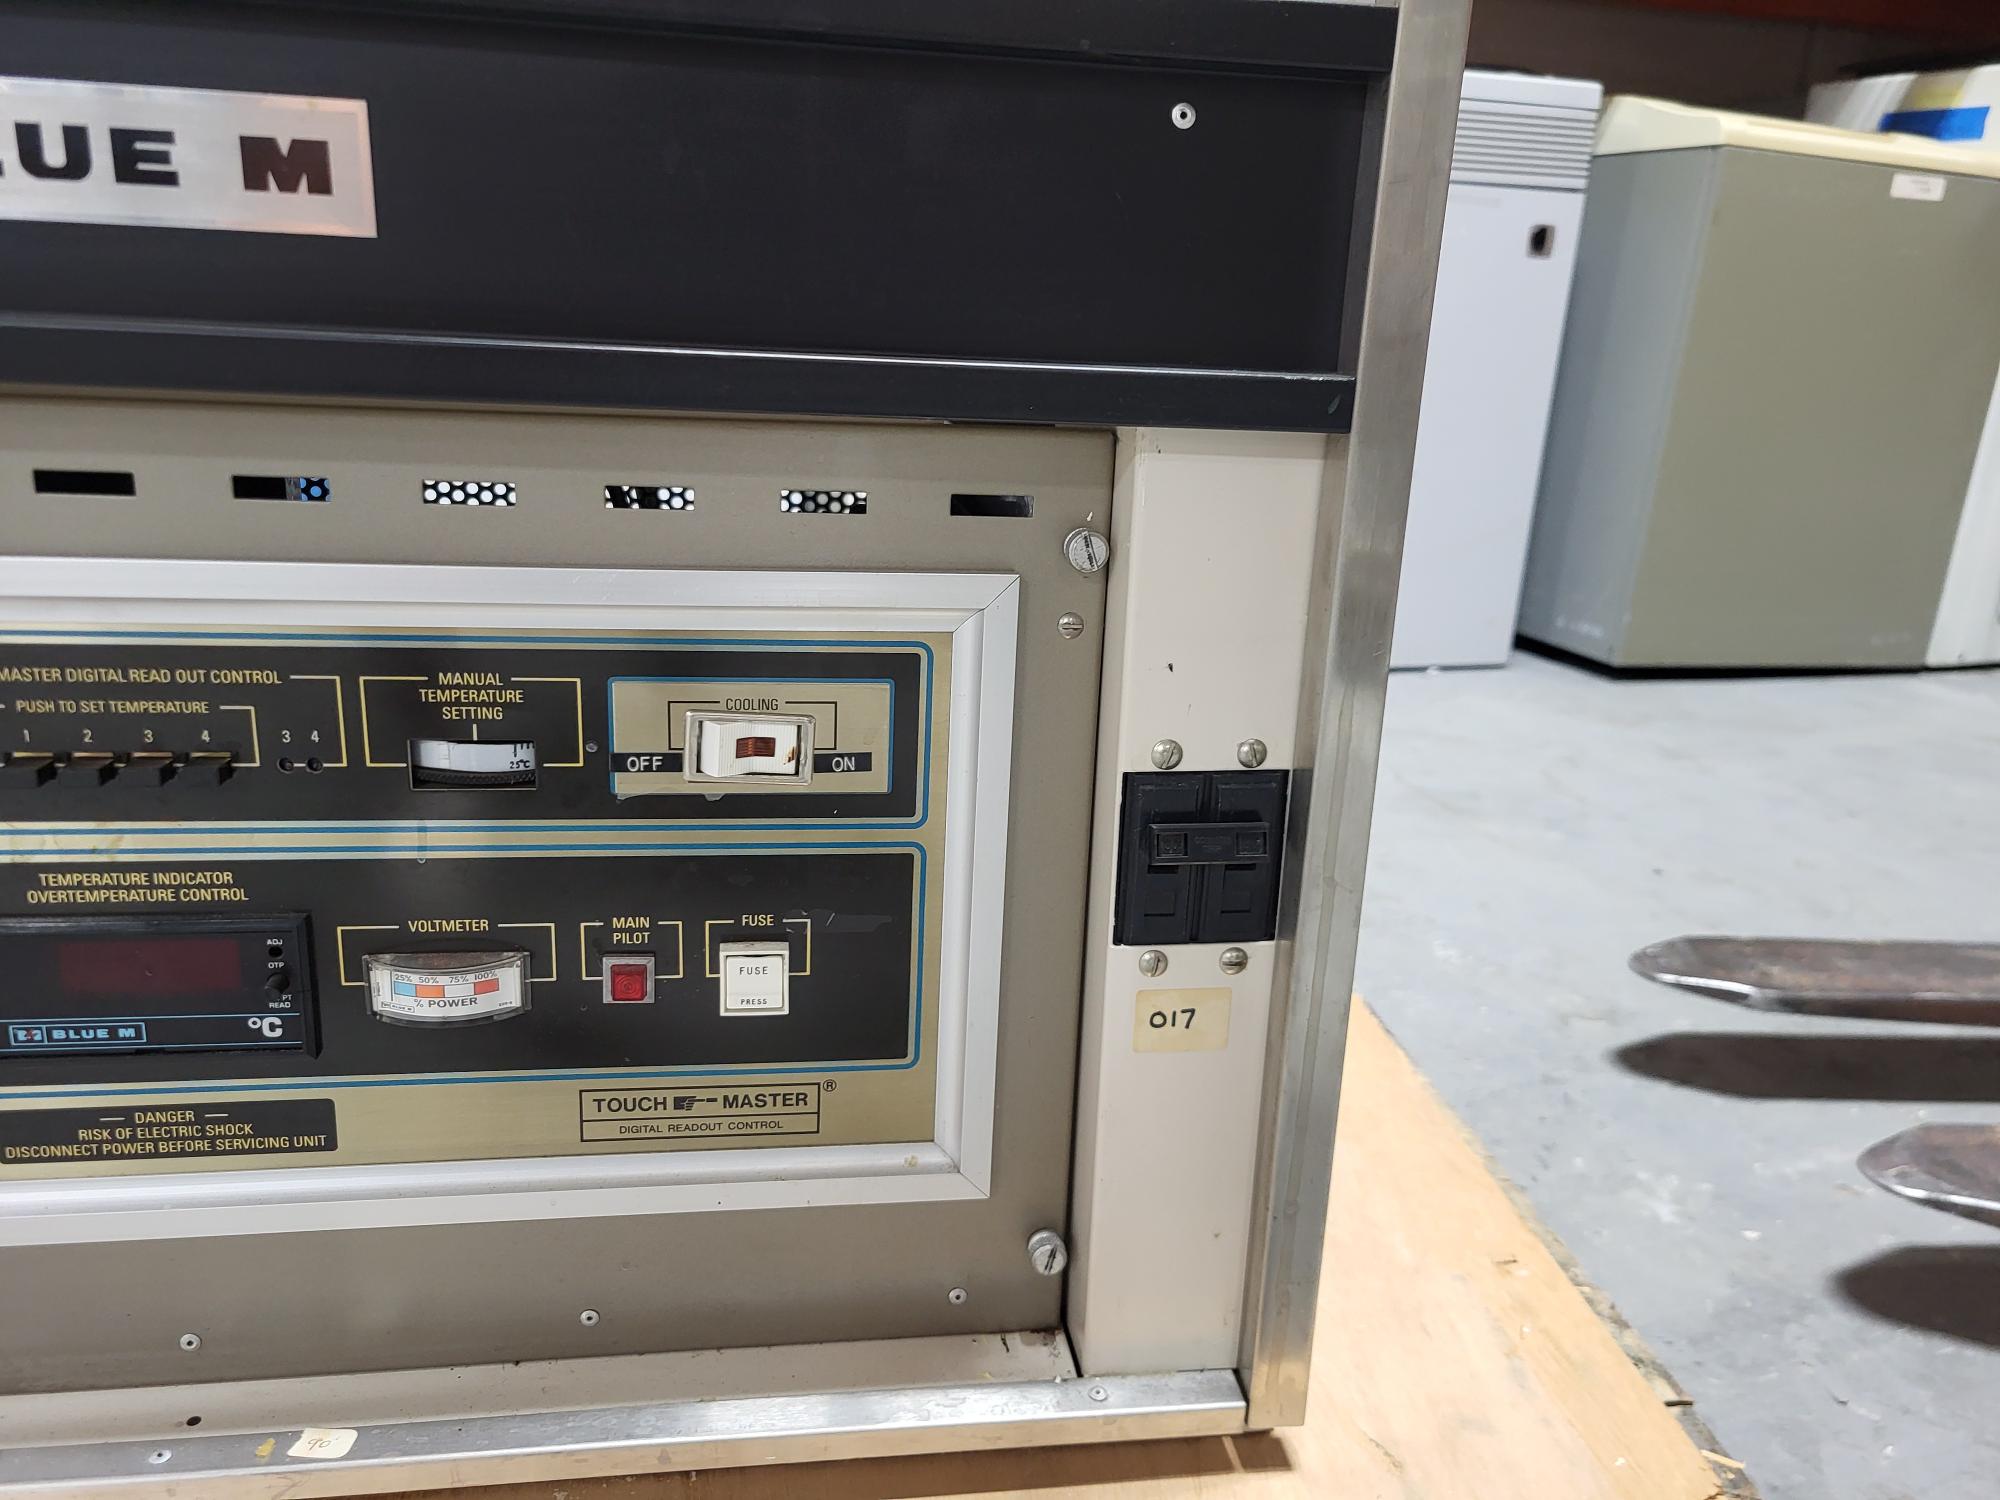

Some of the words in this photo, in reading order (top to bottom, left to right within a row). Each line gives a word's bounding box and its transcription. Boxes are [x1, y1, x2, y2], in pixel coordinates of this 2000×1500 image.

[0, 121, 181, 187] UE
[238, 134, 334, 196] M
[0, 667, 62, 683] MASTER
[65, 668, 127, 683] DIGITAL
[129, 668, 171, 684] READ
[175, 669, 206, 684] OUT
[210, 669, 283, 685] CONTROL
[438, 672, 504, 686] MANUAL
[419, 688, 525, 703] TEMPERATURE
[16, 700, 55, 714] PUSH
[58, 700, 77, 714] TO
[81, 700, 106, 714] SET
[109, 701, 210, 714] TEMPERATURE
[725, 698, 780, 712] COOLING
[442, 706, 504, 720] SETTING
[23, 729, 30, 743] 1
[82, 729, 93, 743] 2
[143, 729, 154, 743] 3
[201, 729, 211, 743] 4
[281, 730, 291, 743] 3
[310, 730, 320, 743] 4
[626, 755, 663, 772] OFF
[831, 756, 857, 772] ON
[38, 872, 151, 887] TEMPERATURE
[153, 871, 234, 886] INDICATOR
[27, 888, 177, 904] OVERTEMPERATURE
[180, 887, 250, 902] CONTROL
[408, 919, 489, 933] VOLTMETER
[612, 916, 650, 929] MAIN
[742, 914, 775, 927] FUSE
[266, 938, 283, 946] ADJ
[613, 931, 651, 945] PILOT
[267, 961, 285, 969] OTP
[739, 966, 769, 976] FUSE
[394, 973, 413, 983] 25%
[418, 976, 440, 985] 50%
[449, 975, 469, 984] 75%
[474, 970, 498, 981] 100%
[268, 1001, 291, 1009] READ
[414, 998, 424, 1008] %
[428, 997, 478, 1009] POWER
[740, 998, 768, 1006] PRESS
[1149, 1007, 1197, 1030] 017
[51, 1028, 110, 1040] BLUE
[117, 1026, 136, 1038] M
[592, 1096, 668, 1114] TOUCH
[722, 1091, 809, 1110] MASTER
[135, 1110, 196, 1125] DANGER
[78, 1128, 112, 1142] RISK
[116, 1127, 134, 1140] OF
[137, 1125, 202, 1140] ELECTRIC
[205, 1122, 254, 1137] SHOCK
[619, 1124, 664, 1135] DIGITAL
[667, 1122, 723, 1134] READOUT
[727, 1120, 784, 1131] CONTROL
[5, 1143, 99, 1159] DISCONNECT
[102, 1141, 155, 1156] POWER
[158, 1138, 213, 1154] BEFORE
[215, 1136, 290, 1151] SERVICING
[294, 1134, 328, 1148] UNIT
